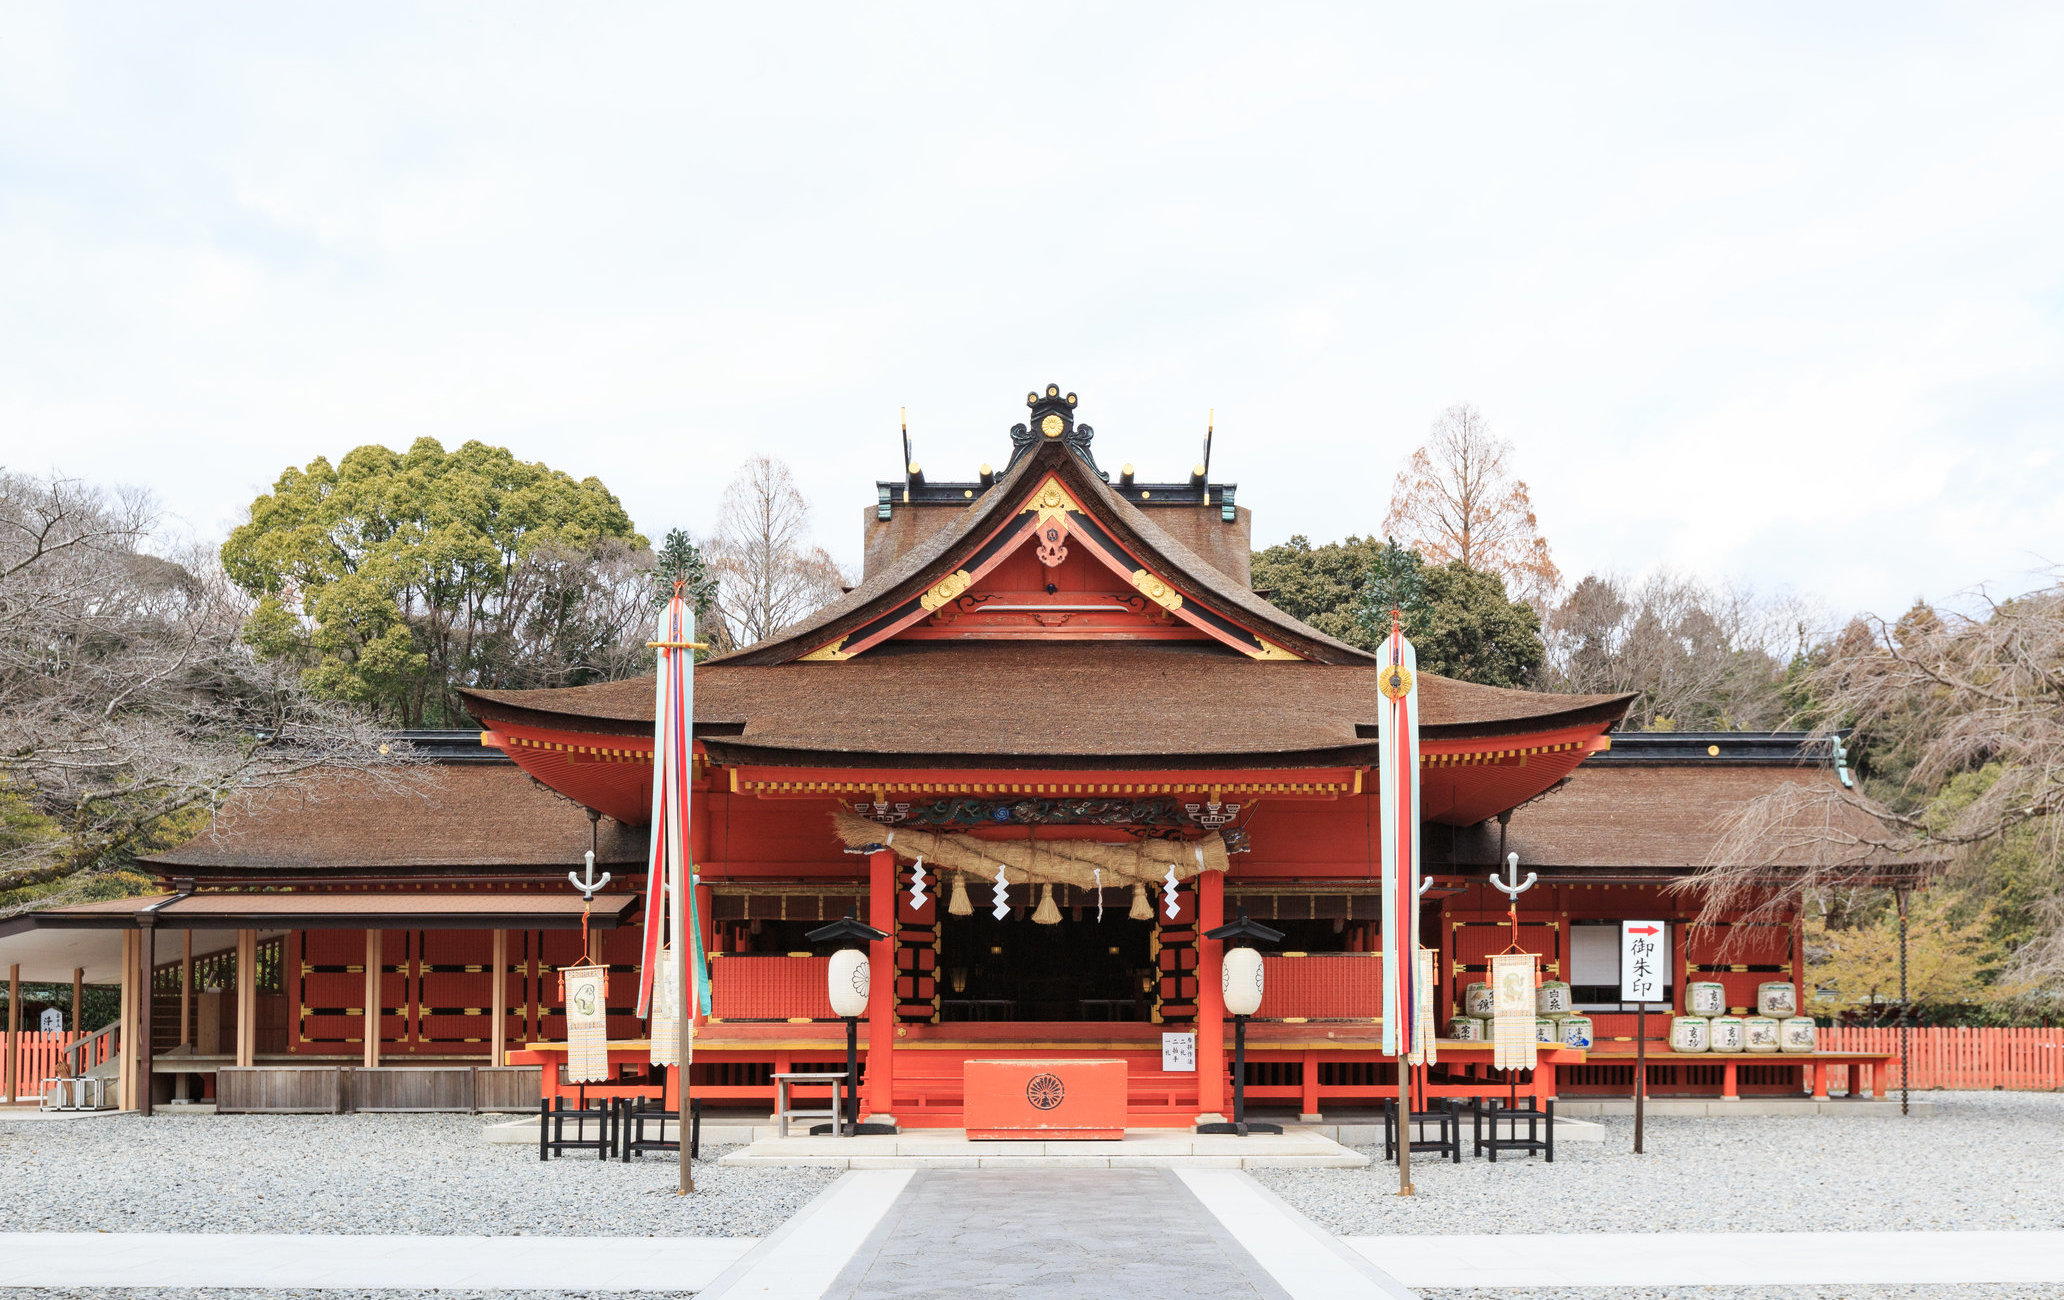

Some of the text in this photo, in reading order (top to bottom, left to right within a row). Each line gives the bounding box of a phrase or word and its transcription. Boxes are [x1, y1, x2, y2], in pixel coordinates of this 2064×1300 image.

[1630, 937, 1655, 998] 御朱印
[1549, 989, 1561, 1011] 白糸
[1709, 990, 1720, 1011] 高砂
[1688, 1026, 1700, 1048] 高砂
[1726, 1026, 1738, 1047] 高砂
